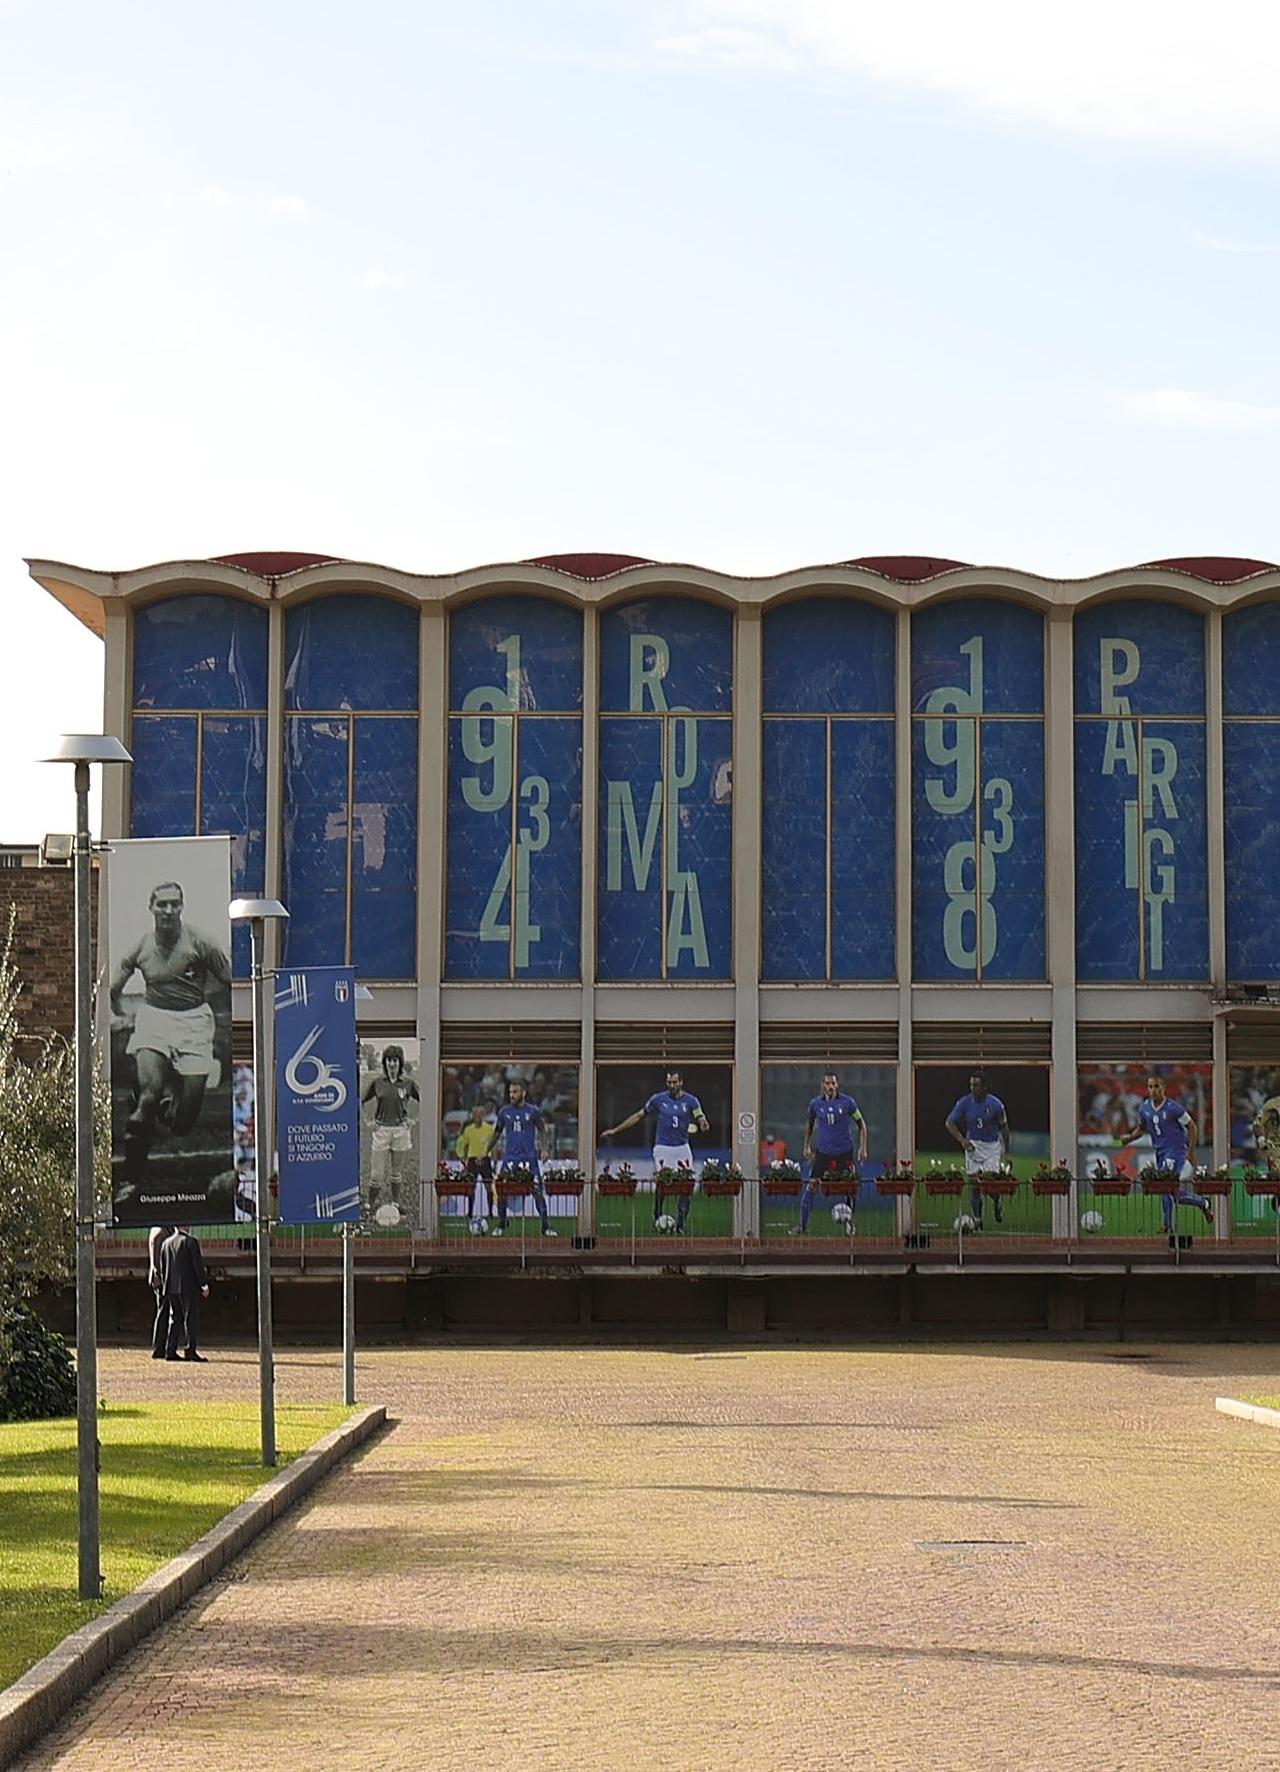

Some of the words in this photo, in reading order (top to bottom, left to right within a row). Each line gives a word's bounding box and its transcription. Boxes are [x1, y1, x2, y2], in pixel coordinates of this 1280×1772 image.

[285, 1023, 347, 1113] 65
[287, 1125, 311, 1134] DOVE
[312, 1123, 349, 1133] PASSATO
[294, 1134, 325, 1144] FUTURO
[296, 1143, 336, 1153] TINGONO
[140, 1194, 176, 1204] Giuseppe
[177, 1193, 206, 1202] Meazza
